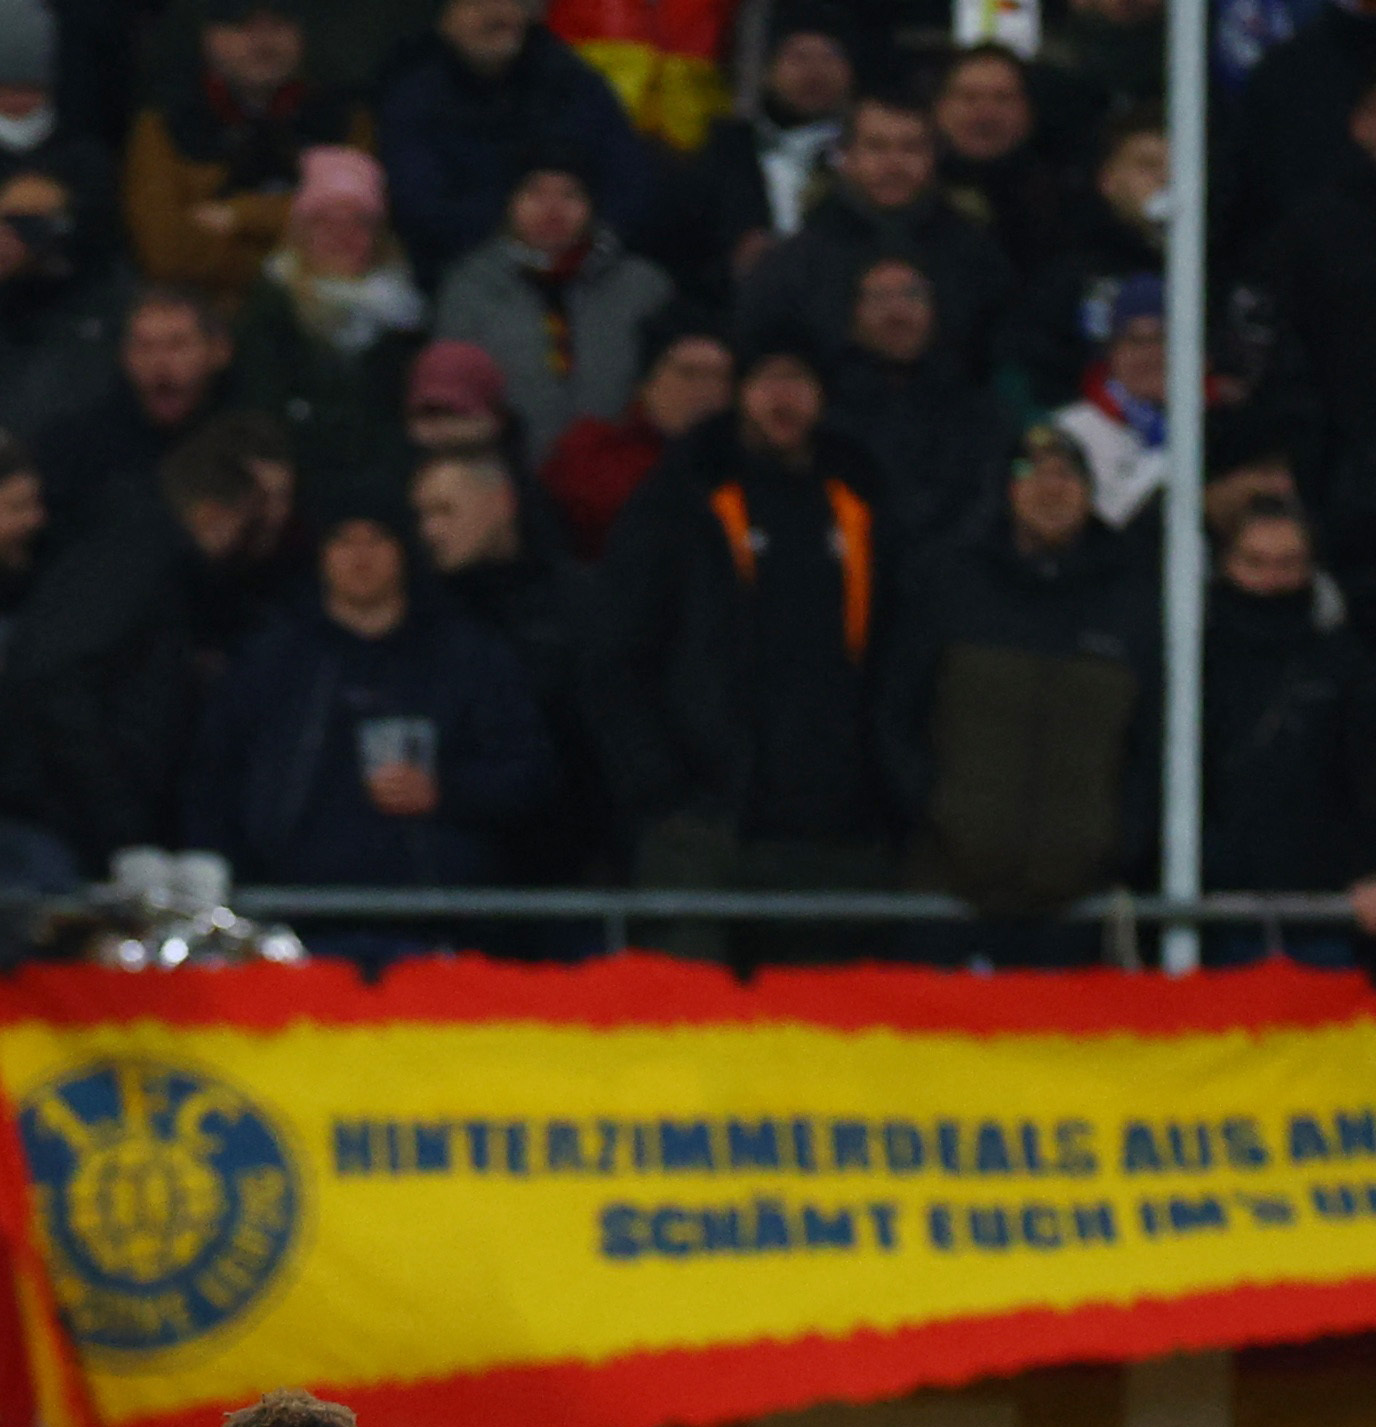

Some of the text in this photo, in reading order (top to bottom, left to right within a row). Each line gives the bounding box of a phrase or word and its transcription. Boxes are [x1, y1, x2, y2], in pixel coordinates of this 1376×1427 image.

[1123, 1114, 1269, 1172] AUS
[600, 1192, 898, 1260] SCHÄMT
[930, 1200, 1118, 1248] EUCH
